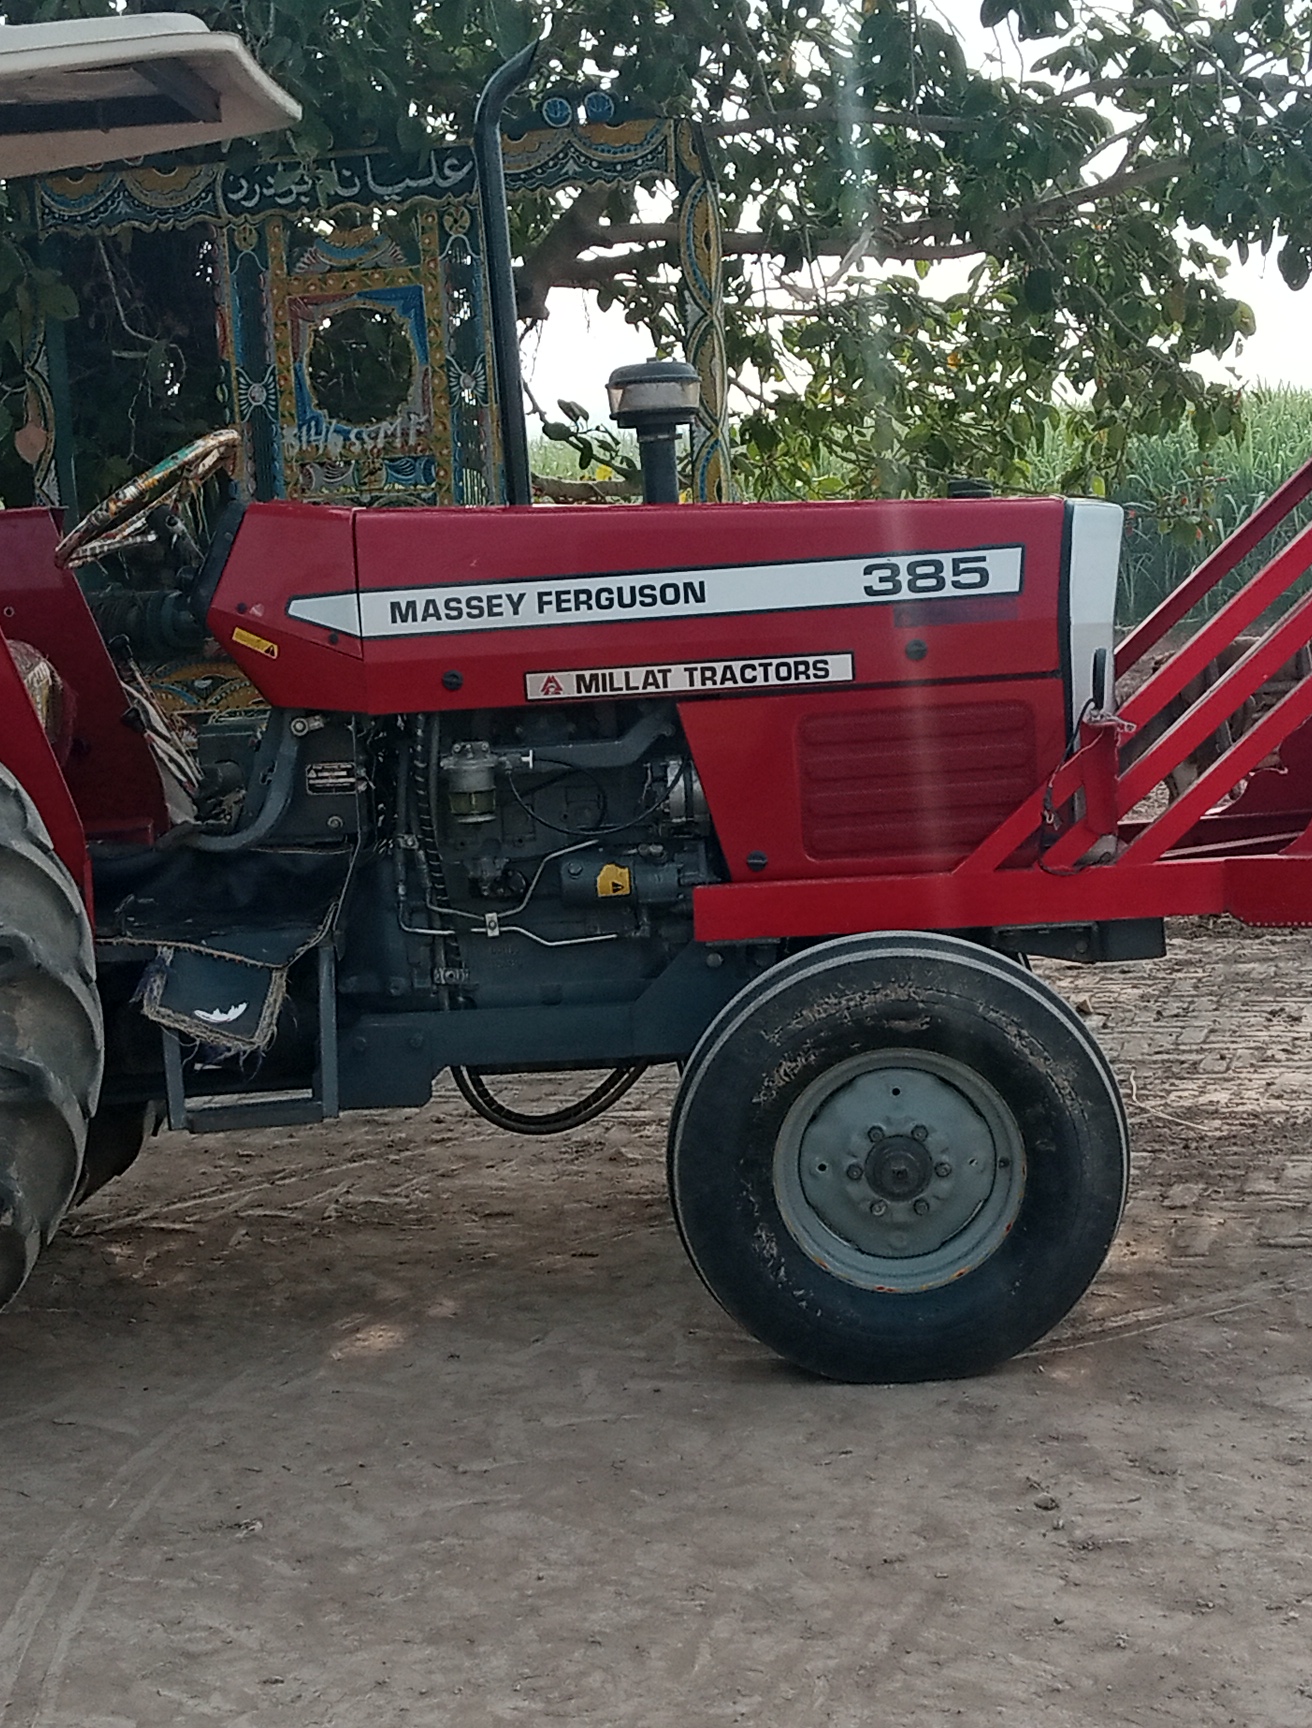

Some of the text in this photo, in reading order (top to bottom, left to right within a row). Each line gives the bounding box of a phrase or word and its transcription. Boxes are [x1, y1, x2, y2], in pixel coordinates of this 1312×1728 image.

[863, 555, 990, 597] 385
[389, 580, 707, 625] MASSEY FERGUSON
[575, 659, 830, 694] MILLAT TRACTORS
